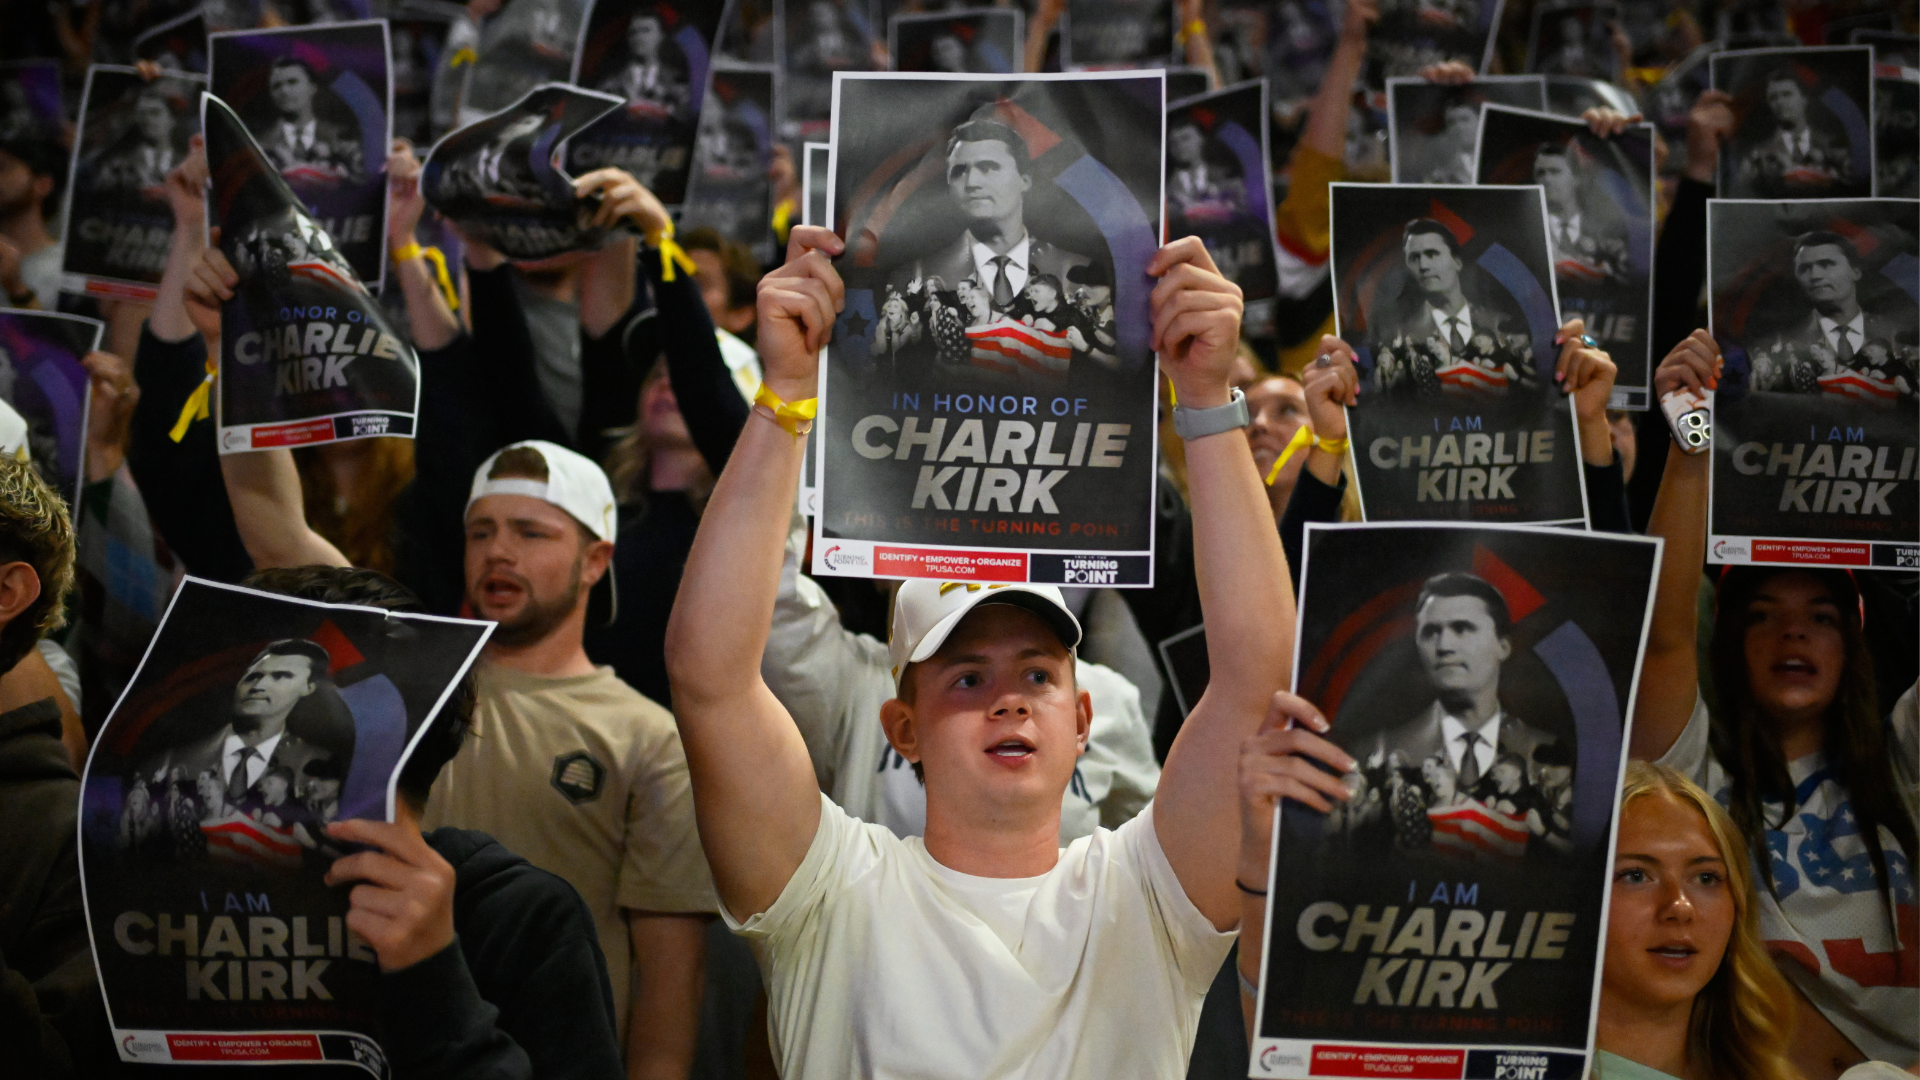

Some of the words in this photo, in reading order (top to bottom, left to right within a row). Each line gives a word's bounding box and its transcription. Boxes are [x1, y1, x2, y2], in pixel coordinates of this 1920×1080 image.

[279, 306, 337, 321] ONOR
[234, 321, 402, 366] CHARLIE
[275, 355, 357, 397] KIRK
[892, 393, 920, 411] IN
[933, 394, 1038, 415] HONOR
[1050, 397, 1088, 416] OF
[351, 416, 390, 426] TURNING
[352, 424, 389, 435] POINT
[1434, 417, 1440, 433] I
[1449, 415, 1482, 432] AM
[851, 414, 1132, 468] CHARLIE
[1810, 425, 1816, 441] I
[1827, 426, 1864, 443] AM
[1368, 429, 1556, 470] CHARLIE
[1732, 441, 1919, 481] CHARLI
[911, 465, 1070, 515] KIRK
[1417, 465, 1519, 501] KIRK
[1778, 478, 1900, 515] KIRK
[924, 518, 960, 532] THE
[971, 519, 1061, 536] TURNING
[833, 553, 866, 561] TURNING
[1755, 544, 1786, 552] IDENTIFY
[879, 552, 918, 562] IDENTIFY
[925, 555, 970, 565] EMPOWER
[976, 558, 1022, 567] ORGANIZE
[1063, 559, 1119, 570] TURNING
[925, 565, 976, 575] TPUSA.COM
[1064, 569, 1119, 584] POINT
[200, 890, 209, 913] I
[223, 892, 271, 913] AM
[1408, 880, 1417, 903] I
[1429, 881, 1479, 905] AM
[1296, 901, 1576, 960] CHARLIE
[185, 959, 335, 1001] KIRK
[1353, 957, 1512, 1010] KIRK
[173, 1039, 211, 1047] IDENTIFY
[218, 1039, 262, 1048] EMPOWER
[268, 1039, 312, 1048] ORGANIZE
[1316, 1051, 1357, 1061] IDENTIFY
[1364, 1053, 1409, 1063] EMPOWER
[1415, 1055, 1459, 1064] ORGANIZE
[1496, 1054, 1549, 1066] TURNING
[1495, 1066, 1549, 1080] POINT
